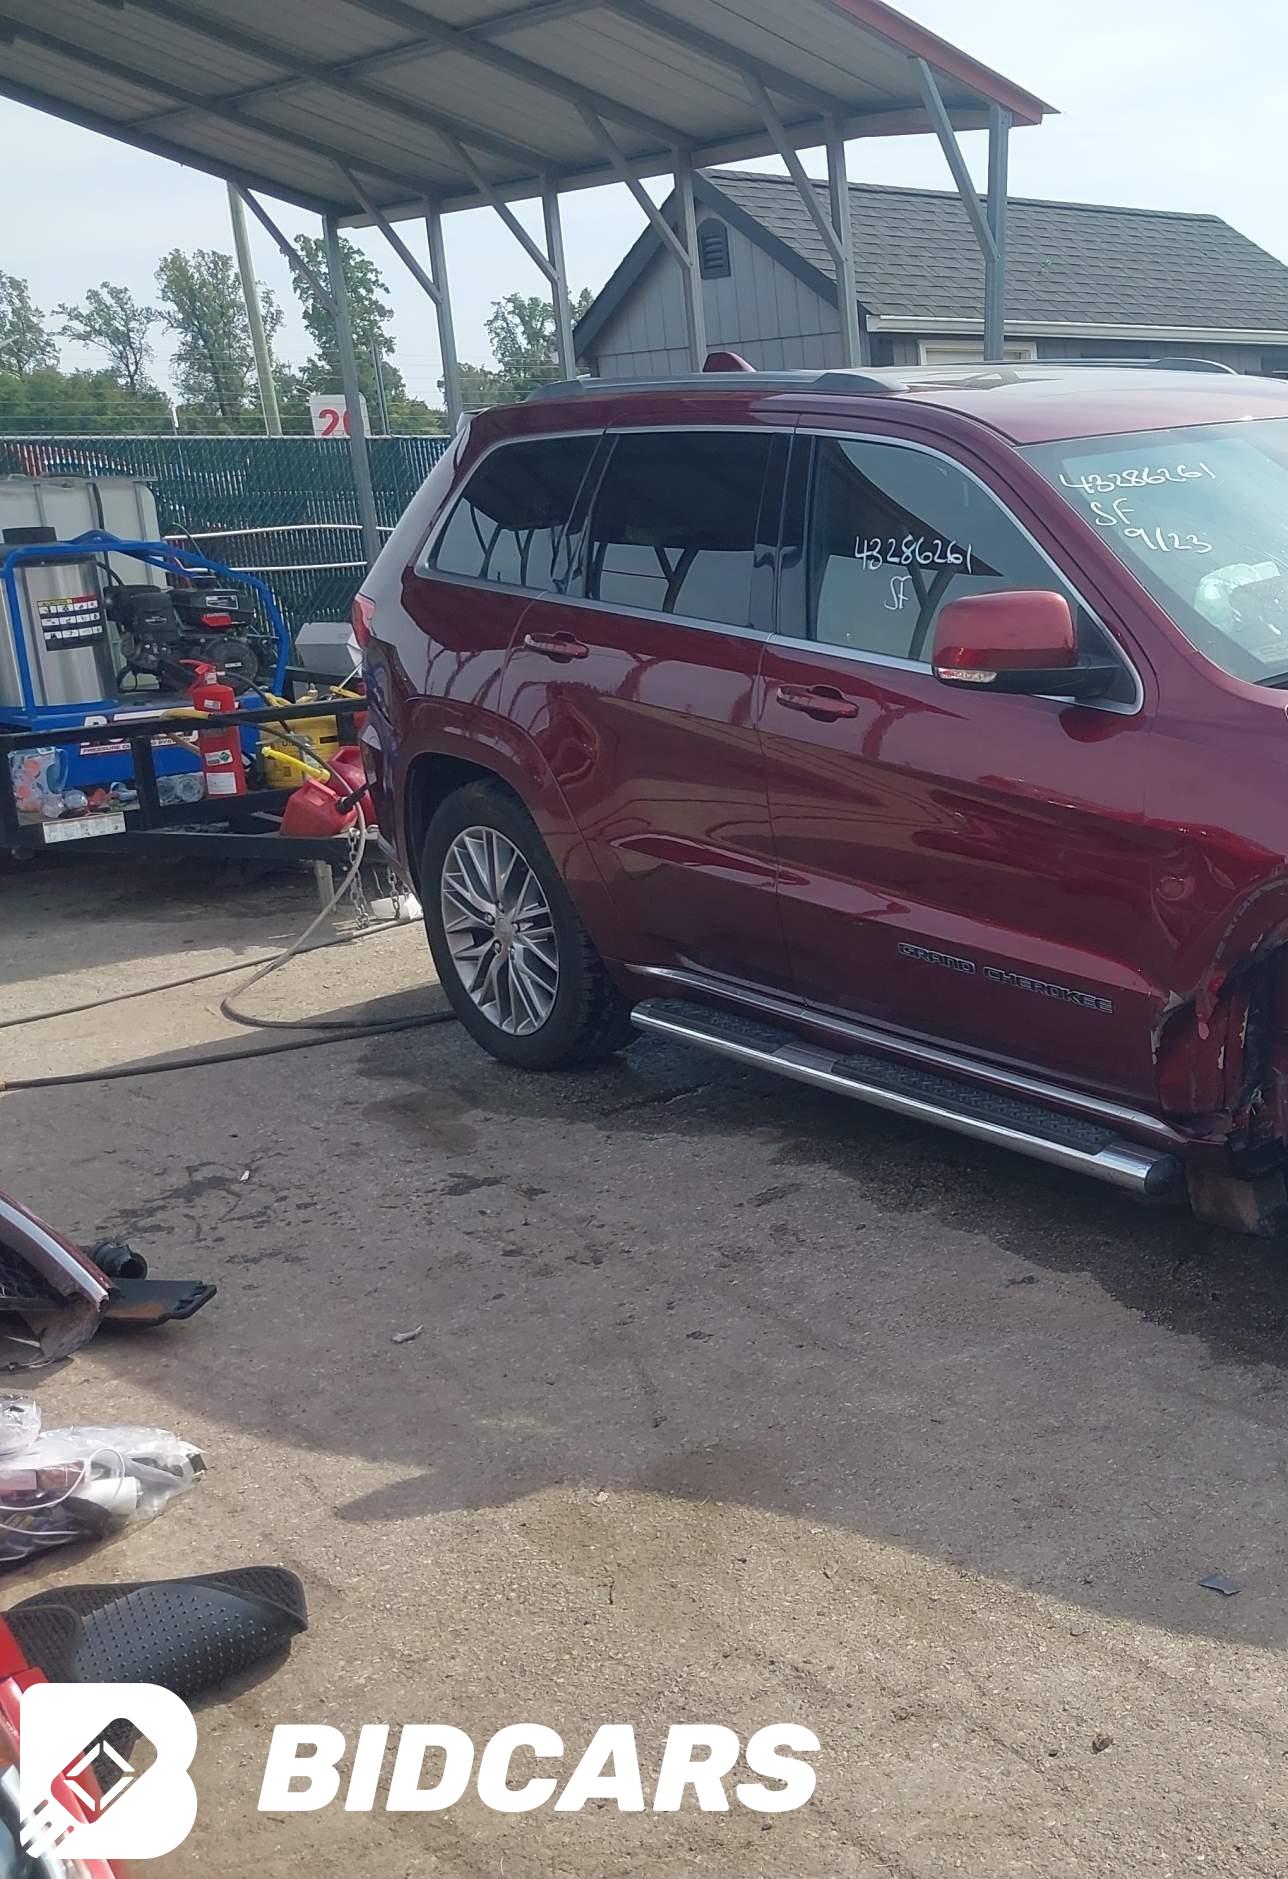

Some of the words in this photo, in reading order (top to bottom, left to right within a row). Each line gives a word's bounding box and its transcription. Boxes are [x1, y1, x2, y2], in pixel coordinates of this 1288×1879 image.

[1059, 462, 1217, 494] 43286261
[1090, 498, 1135, 526] SF
[854, 534, 972, 575] 43286261
[1123, 527, 1213, 554] 9/23
[884, 575, 913, 610] SF
[898, 942, 976, 975] GRAND
[983, 966, 1113, 1014] CHEROKEE
